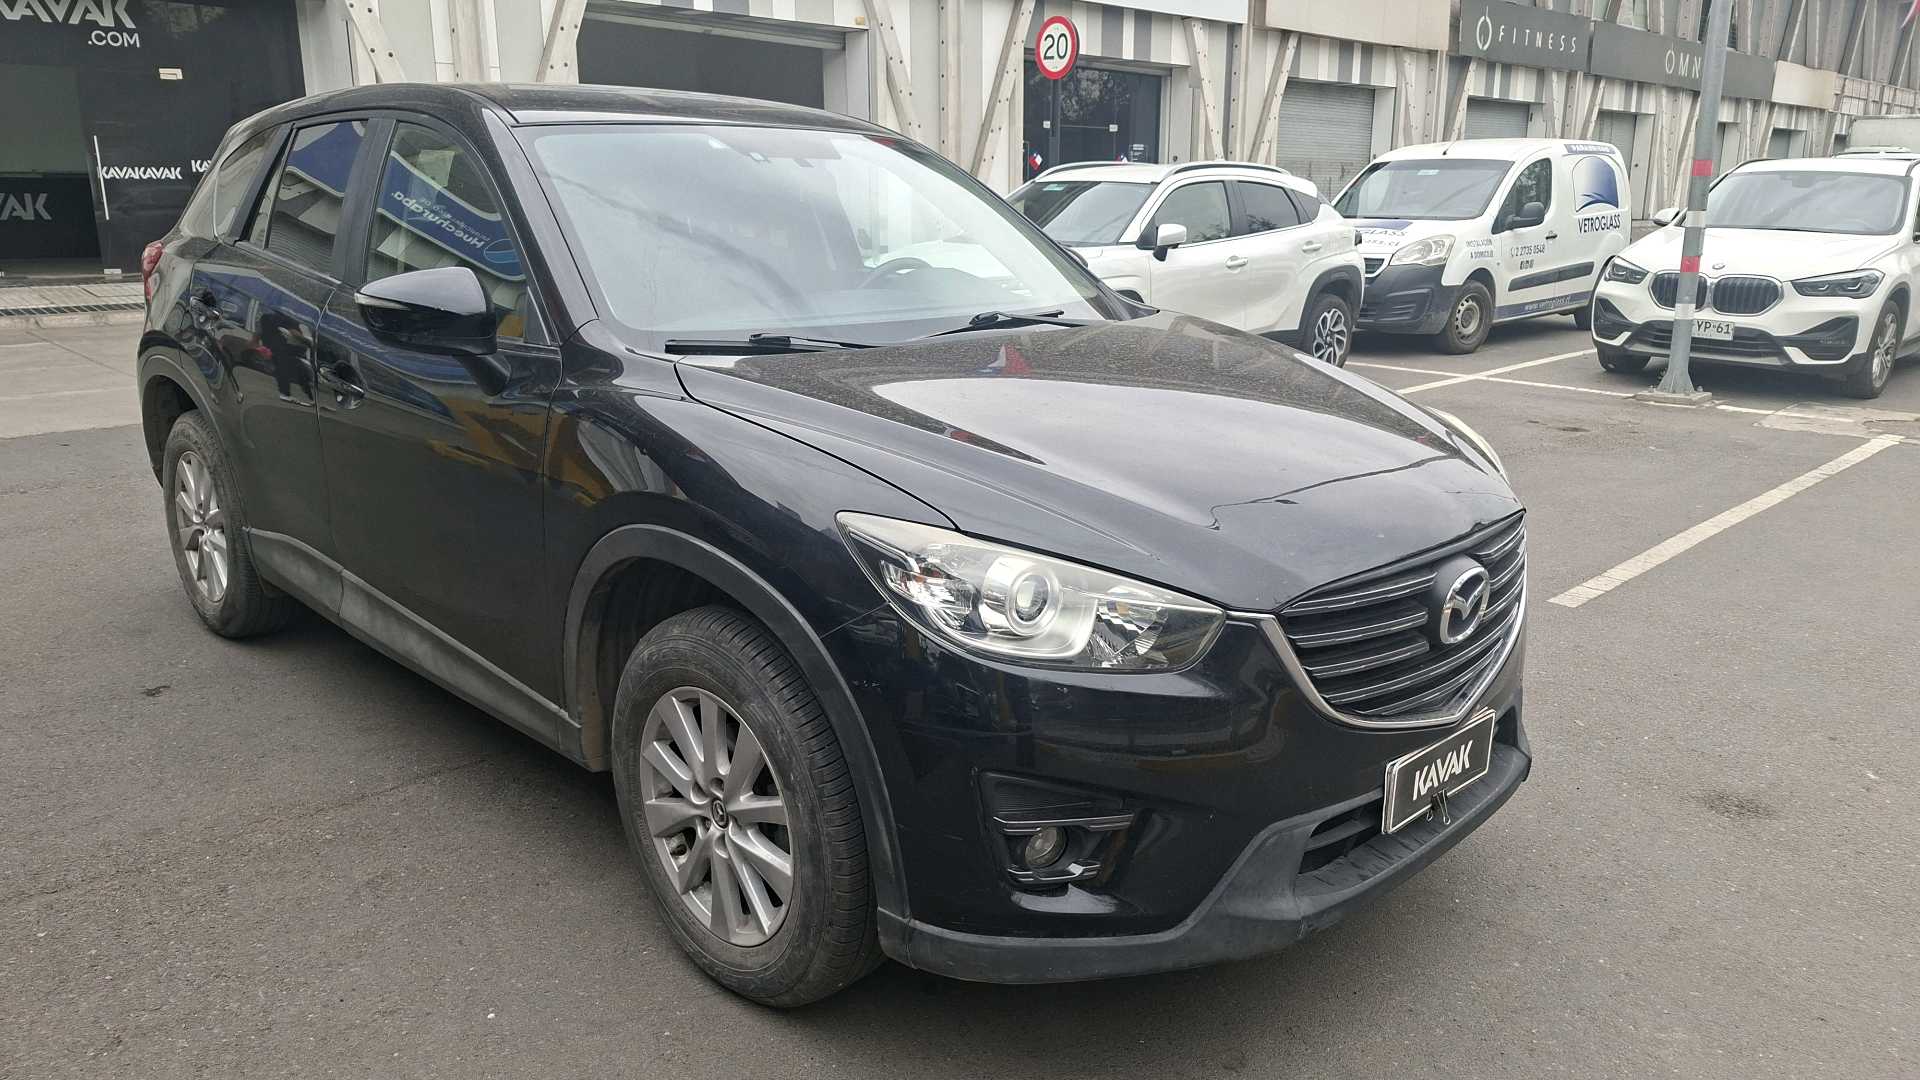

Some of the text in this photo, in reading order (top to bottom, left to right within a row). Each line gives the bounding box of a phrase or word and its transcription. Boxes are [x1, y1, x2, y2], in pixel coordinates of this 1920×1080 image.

[88, 30, 140, 48] .COM
[1043, 33, 1068, 60] 20
[1499, 25, 1577, 53] FITNESS
[1665, 42, 1702, 79] OMN
[1578, 214, 1621, 234] VETROGLASS
[1413, 740, 1473, 801] KAVAK
